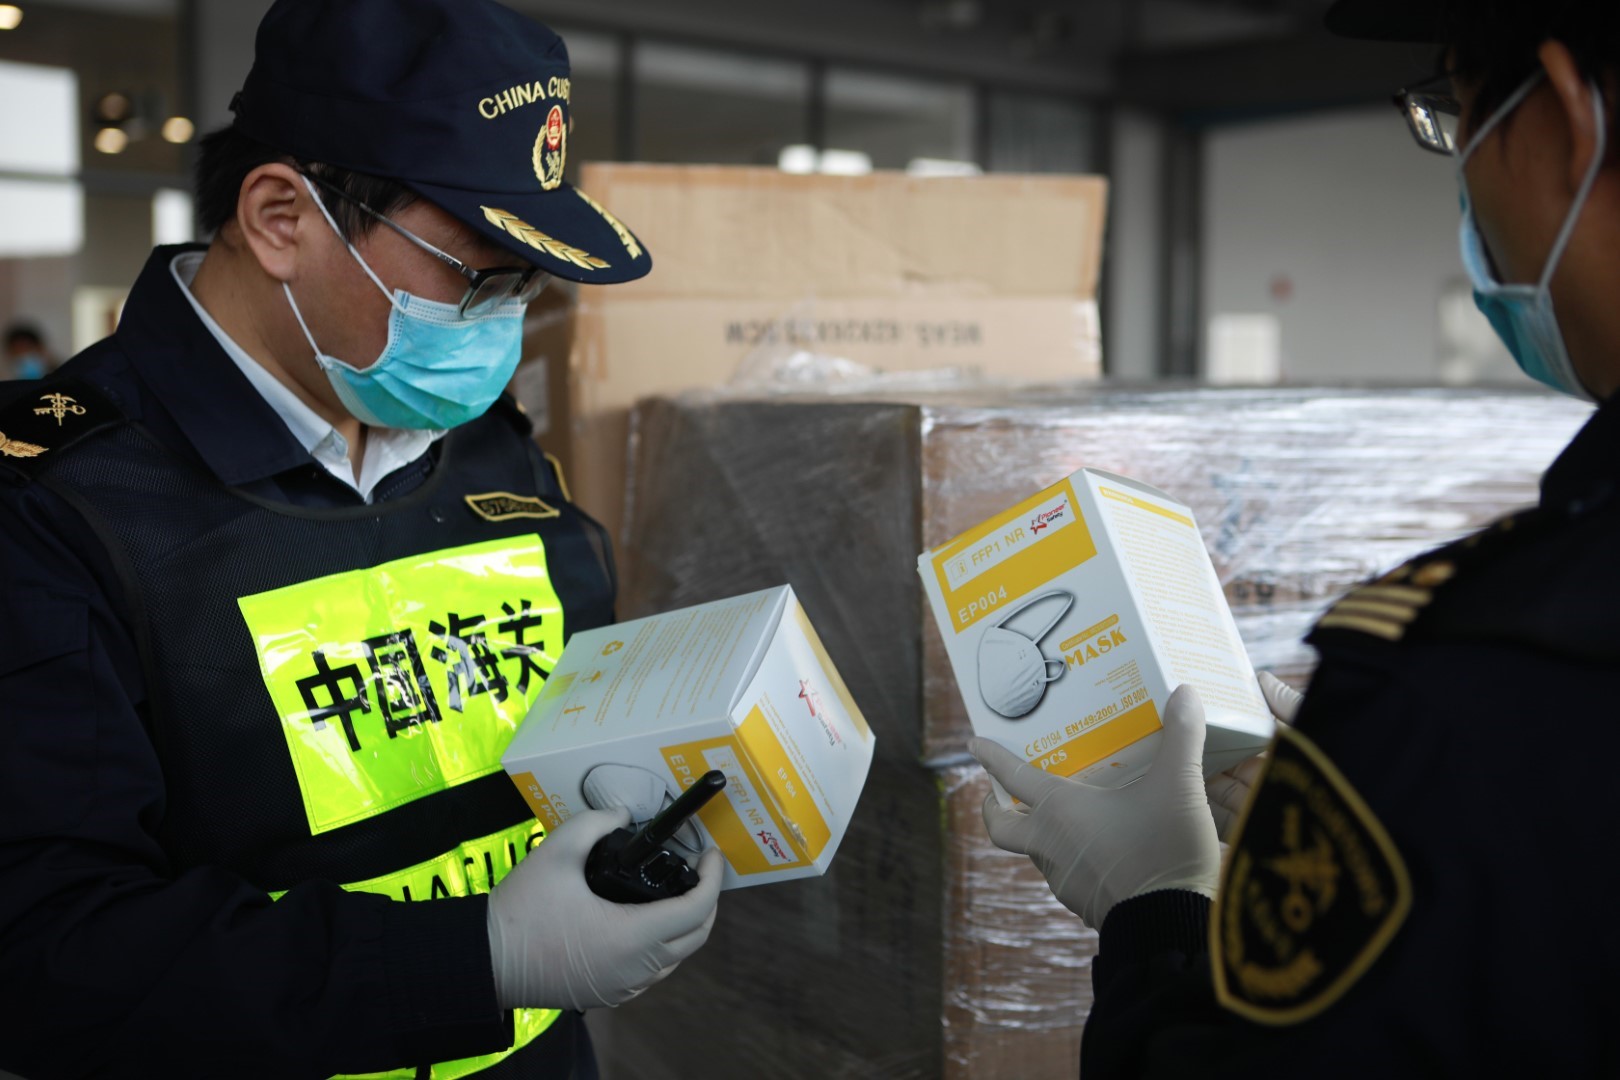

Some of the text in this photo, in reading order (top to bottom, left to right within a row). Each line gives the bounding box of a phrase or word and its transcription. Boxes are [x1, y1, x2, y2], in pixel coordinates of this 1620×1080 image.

[478, 81, 545, 119] CHINA
[971, 527, 1025, 566] FFP1 NR
[958, 584, 1007, 624] EP004
[1064, 626, 1127, 671] MASK
[295, 598, 549, 752] 中国海关
[1040, 730, 1062, 750] 0194
[1065, 703, 1118, 737] EN149:2001
[670, 754, 696, 786] EP0
[1040, 749, 1068, 771] PCS
[528, 784, 544, 800] 20
[727, 775, 764, 826] FFP1 NR
